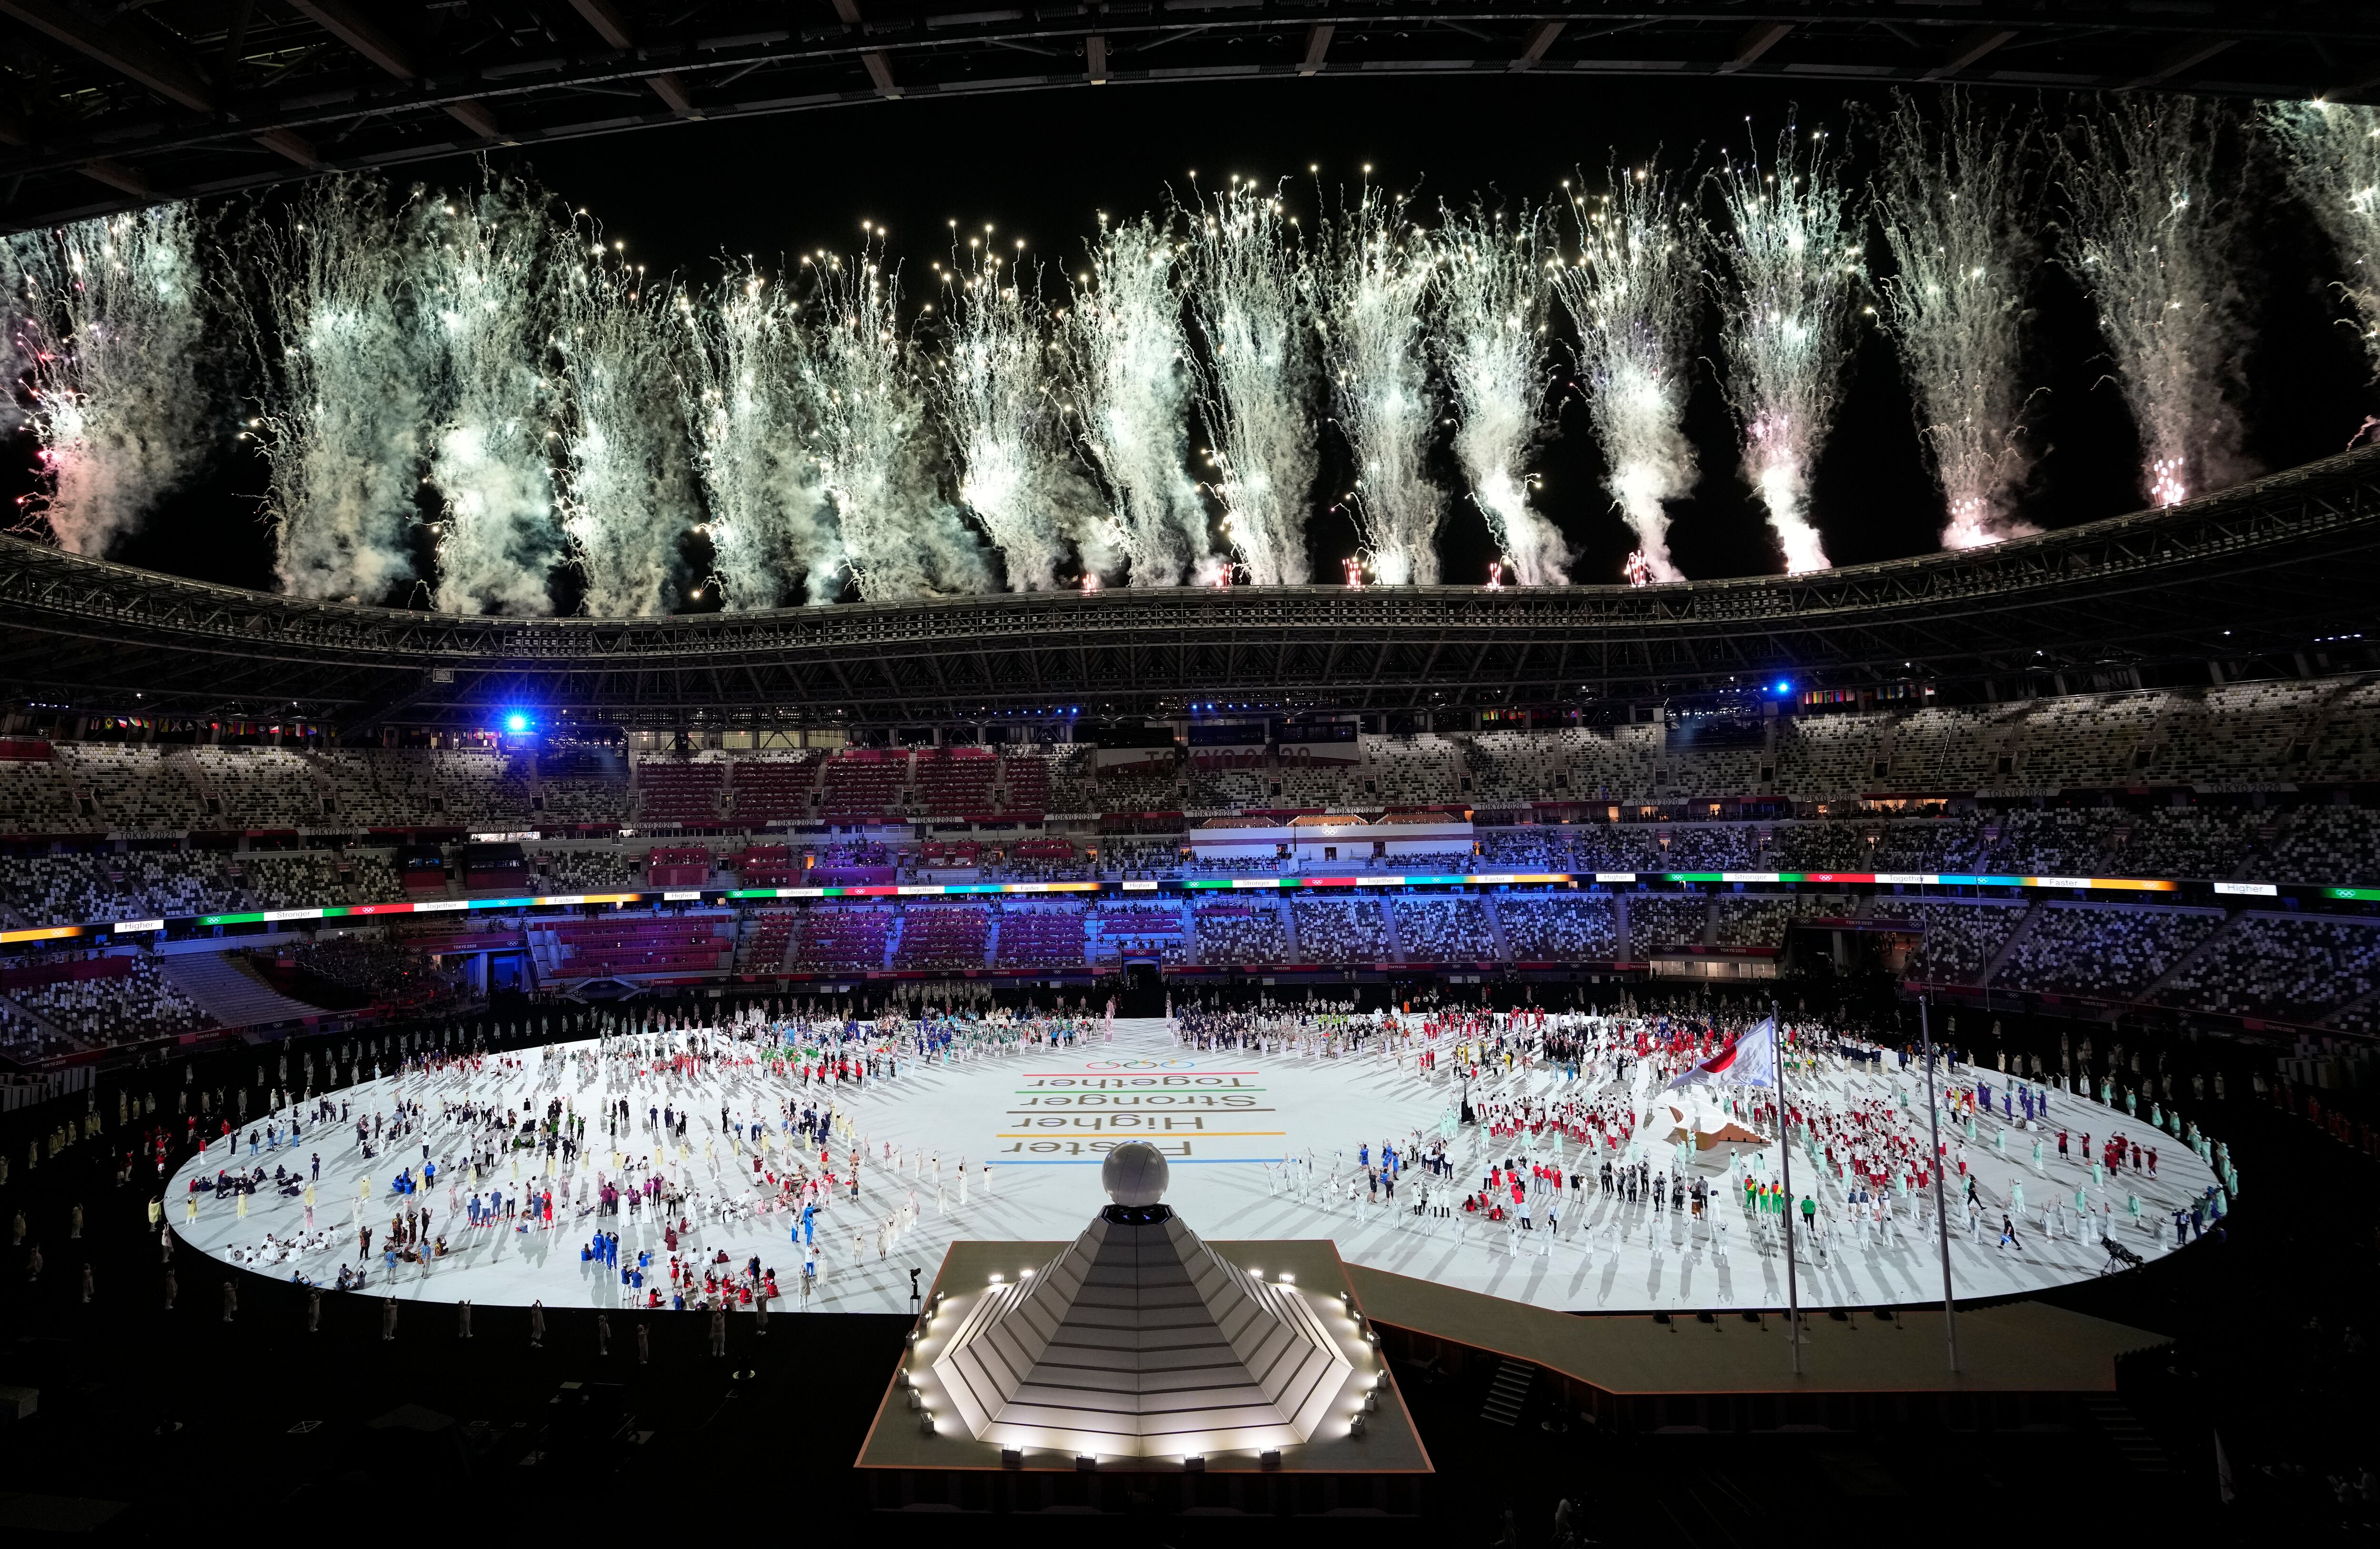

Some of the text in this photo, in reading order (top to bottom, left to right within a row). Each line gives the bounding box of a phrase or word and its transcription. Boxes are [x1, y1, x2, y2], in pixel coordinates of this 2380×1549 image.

[2228, 884, 2263, 894] Higher
[1027, 1076, 1255, 1089] Together
[1019, 1093, 1257, 1107] Stronger
[1012, 1114, 1204, 1130] Higher
[1001, 1141, 1192, 1155] Fster
